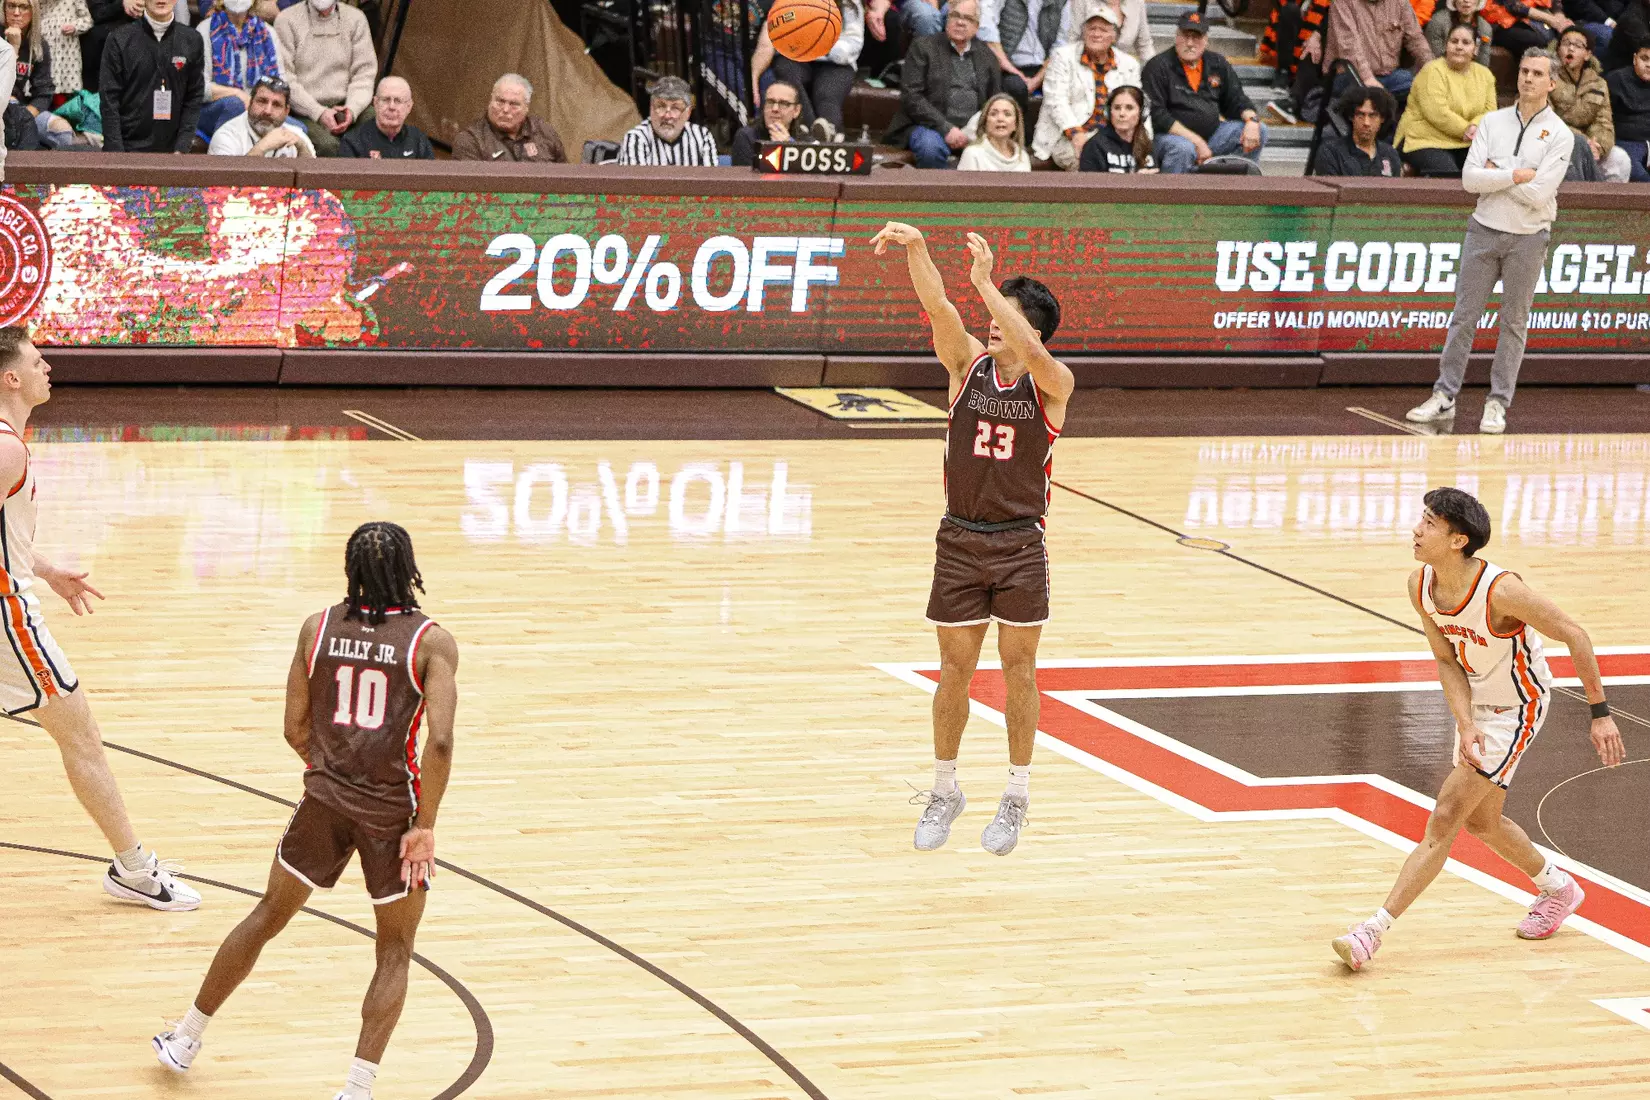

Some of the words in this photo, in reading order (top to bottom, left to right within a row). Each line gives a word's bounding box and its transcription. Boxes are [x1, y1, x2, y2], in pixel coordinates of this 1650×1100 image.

[782, 146, 851, 173] POSS.
[480, 233, 682, 312] 20%
[691, 235, 845, 313] OFF
[1215, 240, 1318, 293] USE
[1323, 241, 1461, 294] CODE
[1492, 244, 1650, 295] GEL
[1213, 311, 1270, 329] OFFER
[1274, 311, 1324, 329] VALID
[1327, 311, 1455, 329] MONDAY-FRID
[1526, 311, 1578, 329] IMUM
[1581, 309, 1612, 332] $10
[1615, 312, 1650, 330] PUR
[968, 388, 1036, 420] BROWN
[972, 420, 1016, 461] 23
[328, 637, 373, 660] LILLY
[374, 643, 398, 665] JR.
[1439, 624, 1488, 647] RINCETON
[333, 664, 389, 731] 10
